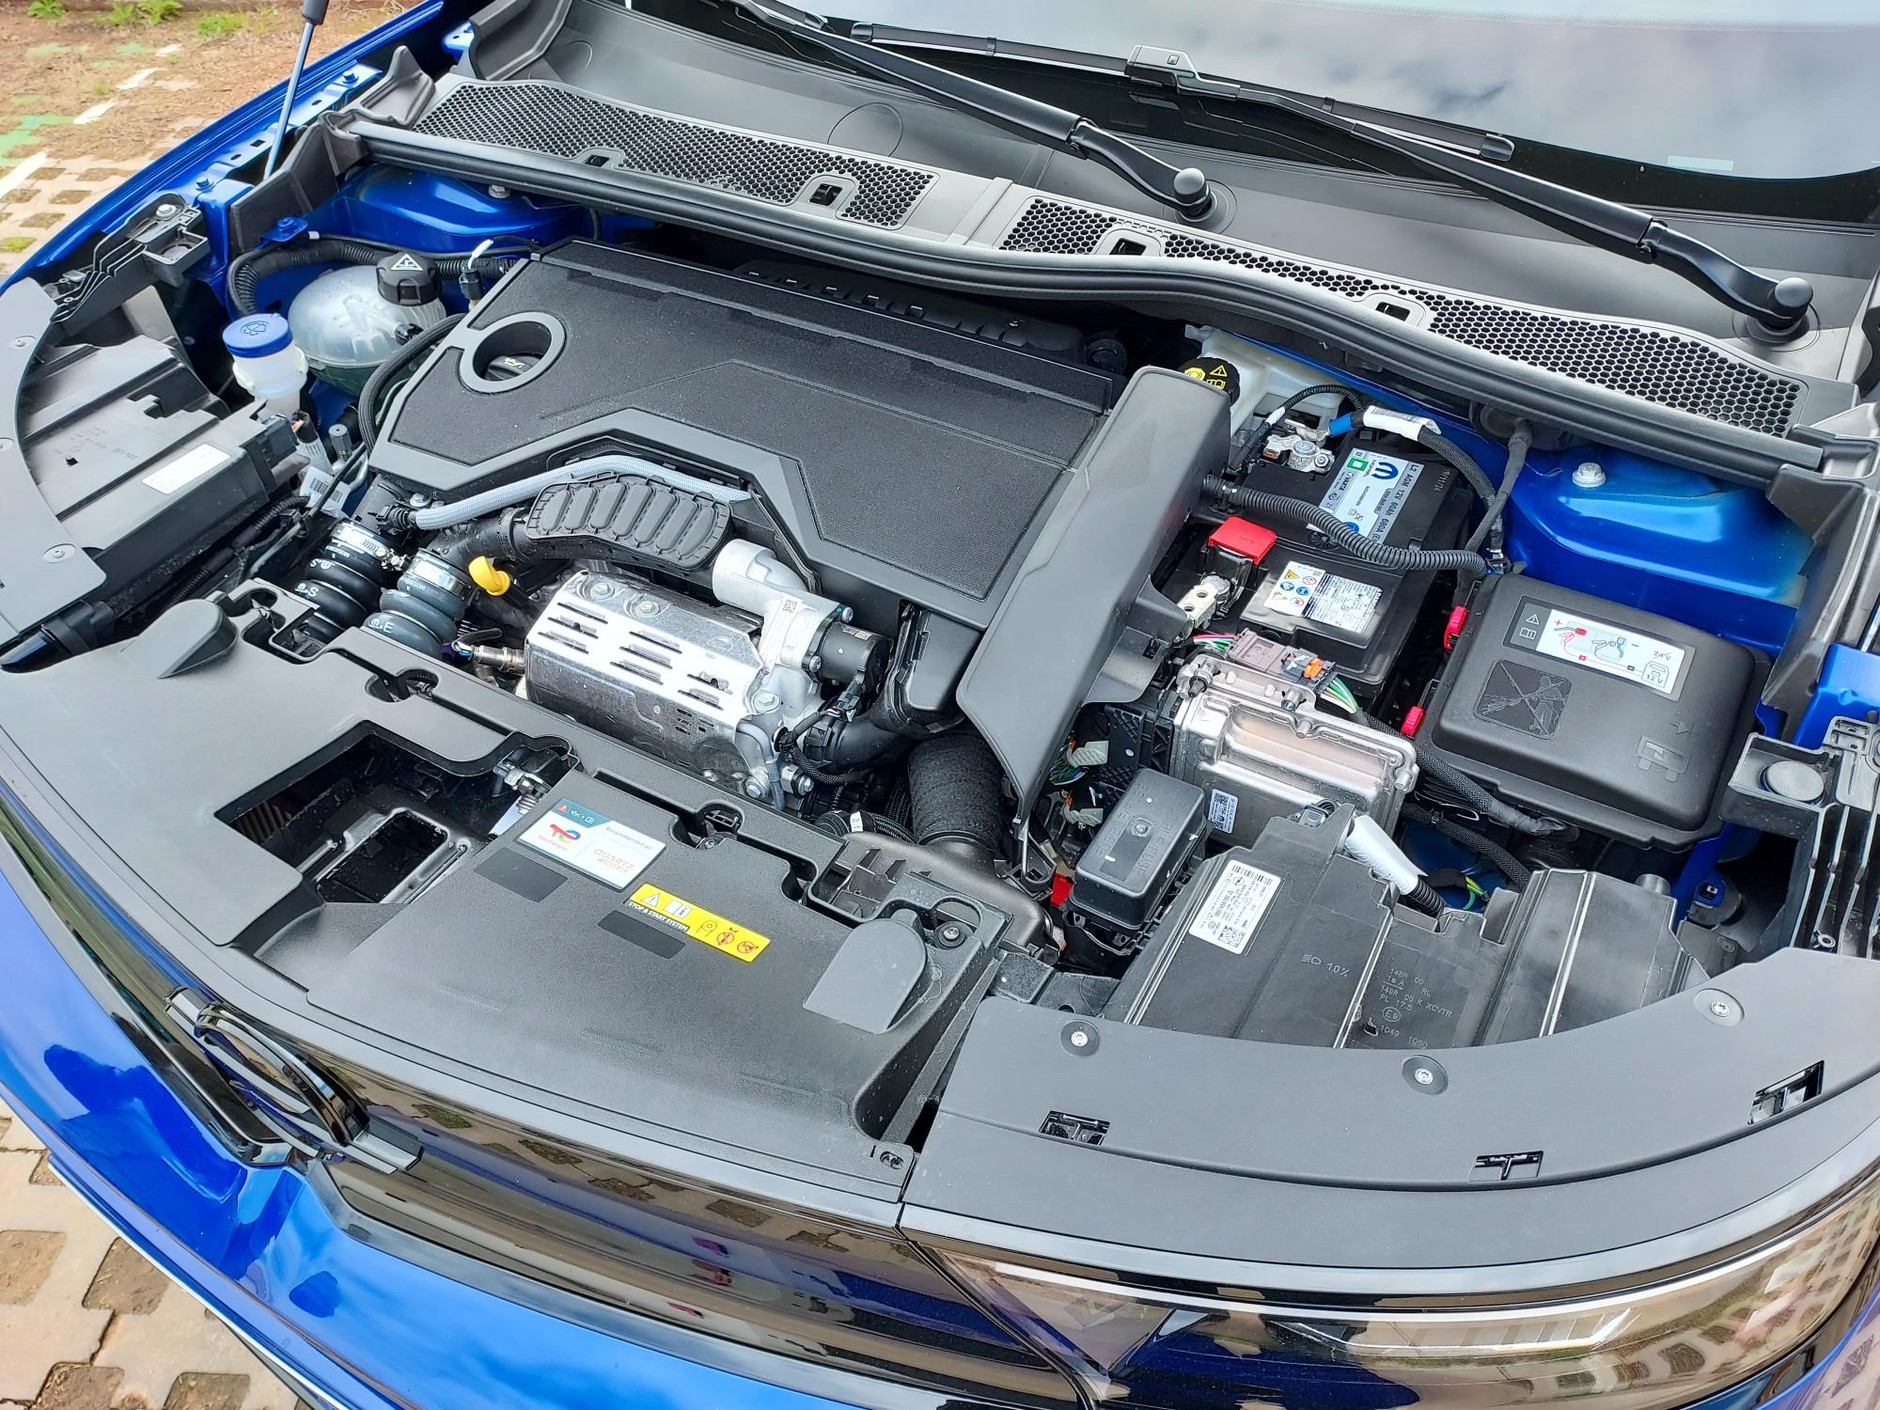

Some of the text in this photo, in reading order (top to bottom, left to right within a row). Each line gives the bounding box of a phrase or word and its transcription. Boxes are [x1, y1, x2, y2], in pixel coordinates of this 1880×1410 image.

[1401, 473, 1414, 486] AGM
[1394, 488, 1405, 499] 12V
[1385, 501, 1399, 515] 60Ah
[383, 621, 394, 633] E
[592, 847, 635, 870] QUARTZ
[627, 899, 643, 911] STOP
[647, 908, 666, 922] START
[665, 916, 688, 932] SYSTEM
[1421, 988, 1431, 997] RL
[1379, 994, 1413, 1011] PL 17.5
[1381, 1025, 1400, 1037] 1049
